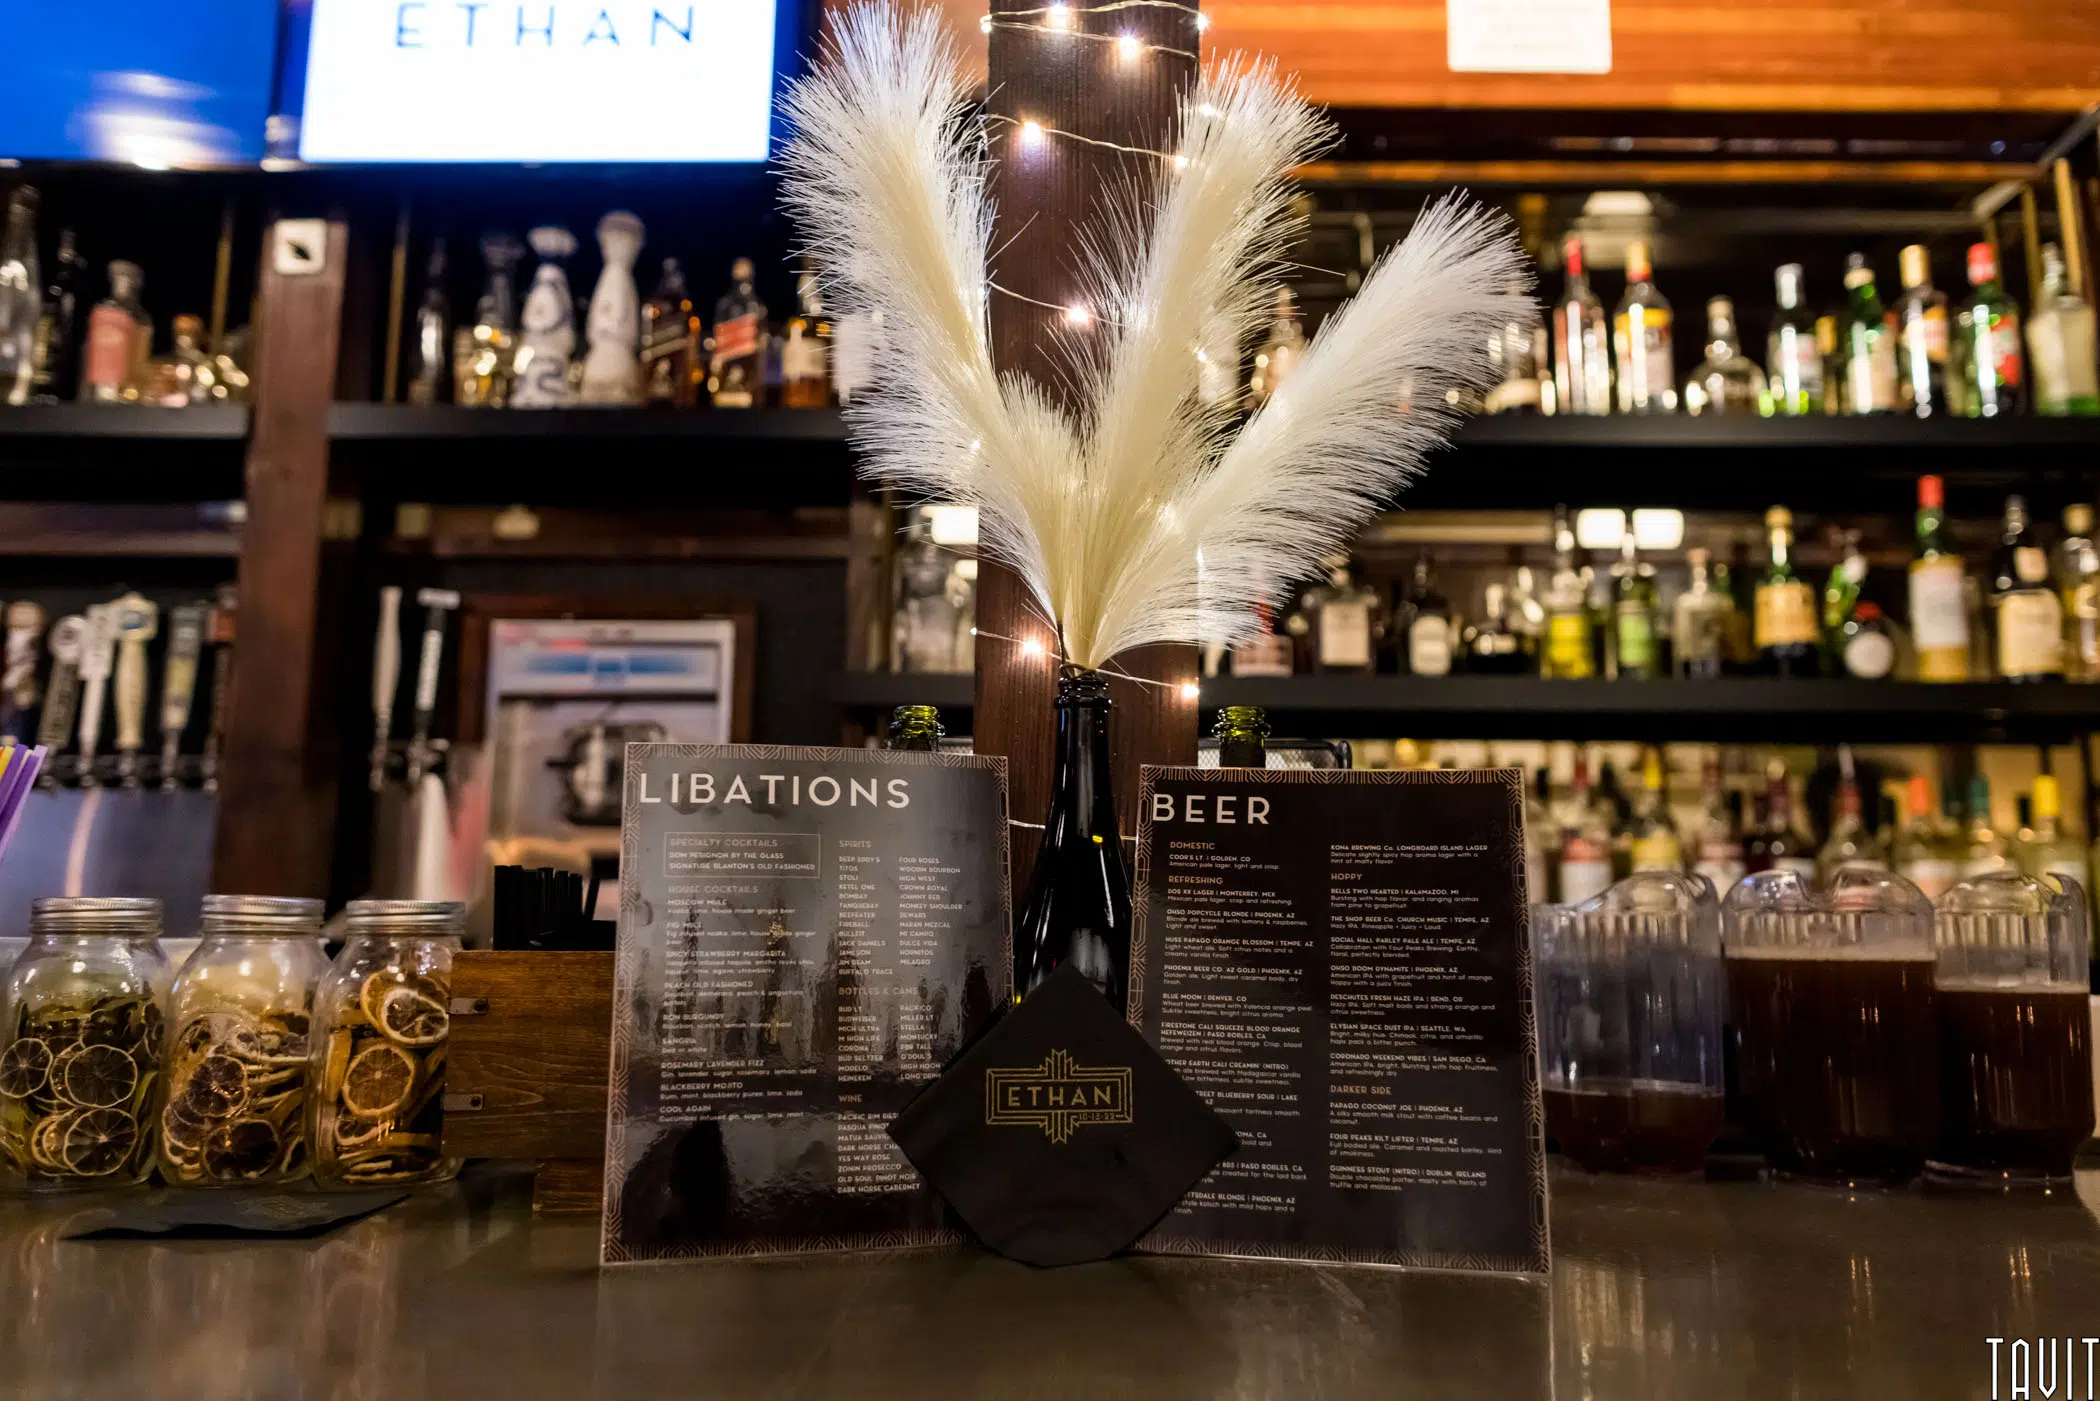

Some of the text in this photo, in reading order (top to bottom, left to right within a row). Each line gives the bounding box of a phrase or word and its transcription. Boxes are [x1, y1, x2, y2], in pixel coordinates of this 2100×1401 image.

[396, 1, 693, 48] ETHAN
[639, 773, 911, 809] LIBATIONS
[1152, 793, 1270, 825] BEER
[669, 839, 778, 847] SPECIALTY COCKTAILS
[1170, 841, 1215, 850] DOMESTIC
[1168, 876, 1223, 884] REFRESHING
[1330, 1085, 1391, 1095] DARKER SIDE
[1008, 1086, 1112, 1107] ETHAN
[1330, 1165, 1364, 1173] GUINNESS
